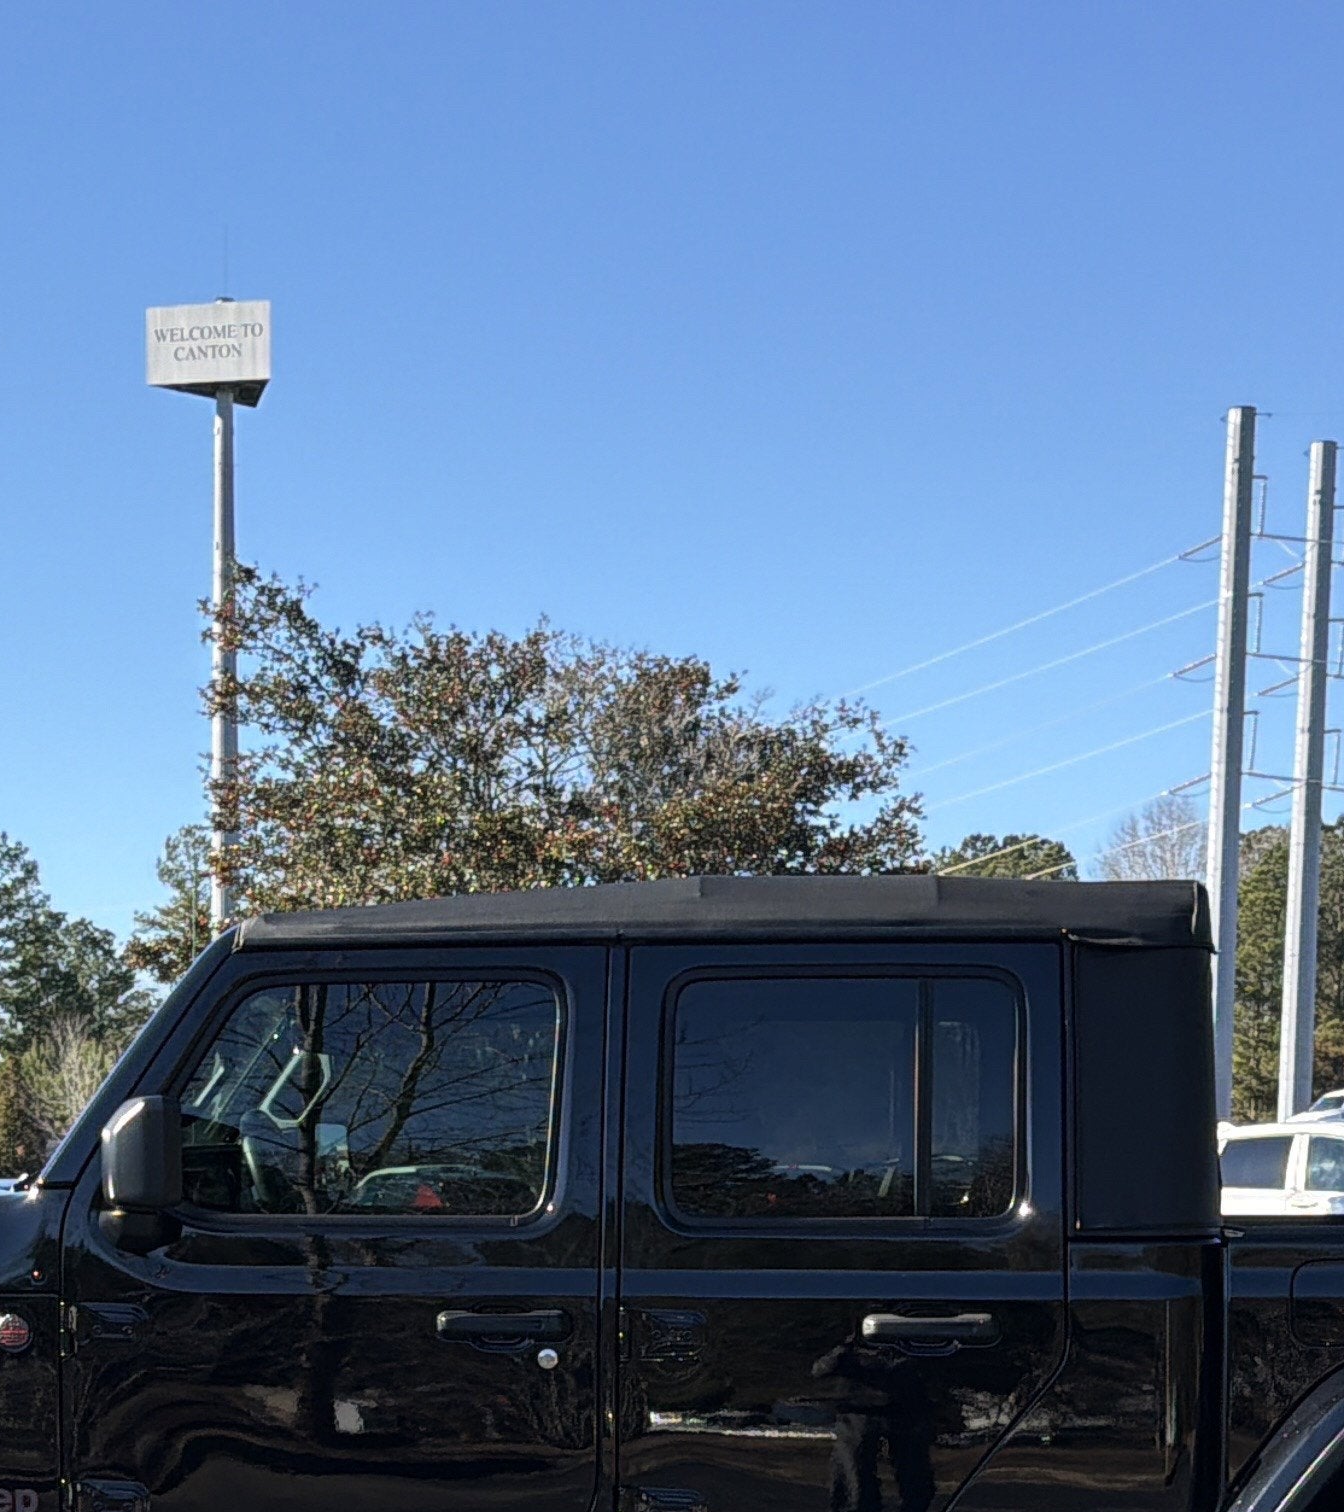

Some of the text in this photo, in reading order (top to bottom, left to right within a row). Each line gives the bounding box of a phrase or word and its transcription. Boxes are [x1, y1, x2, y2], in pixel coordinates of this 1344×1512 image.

[154, 323, 264, 343] WELCOME TO
[174, 343, 242, 362] CANTON
